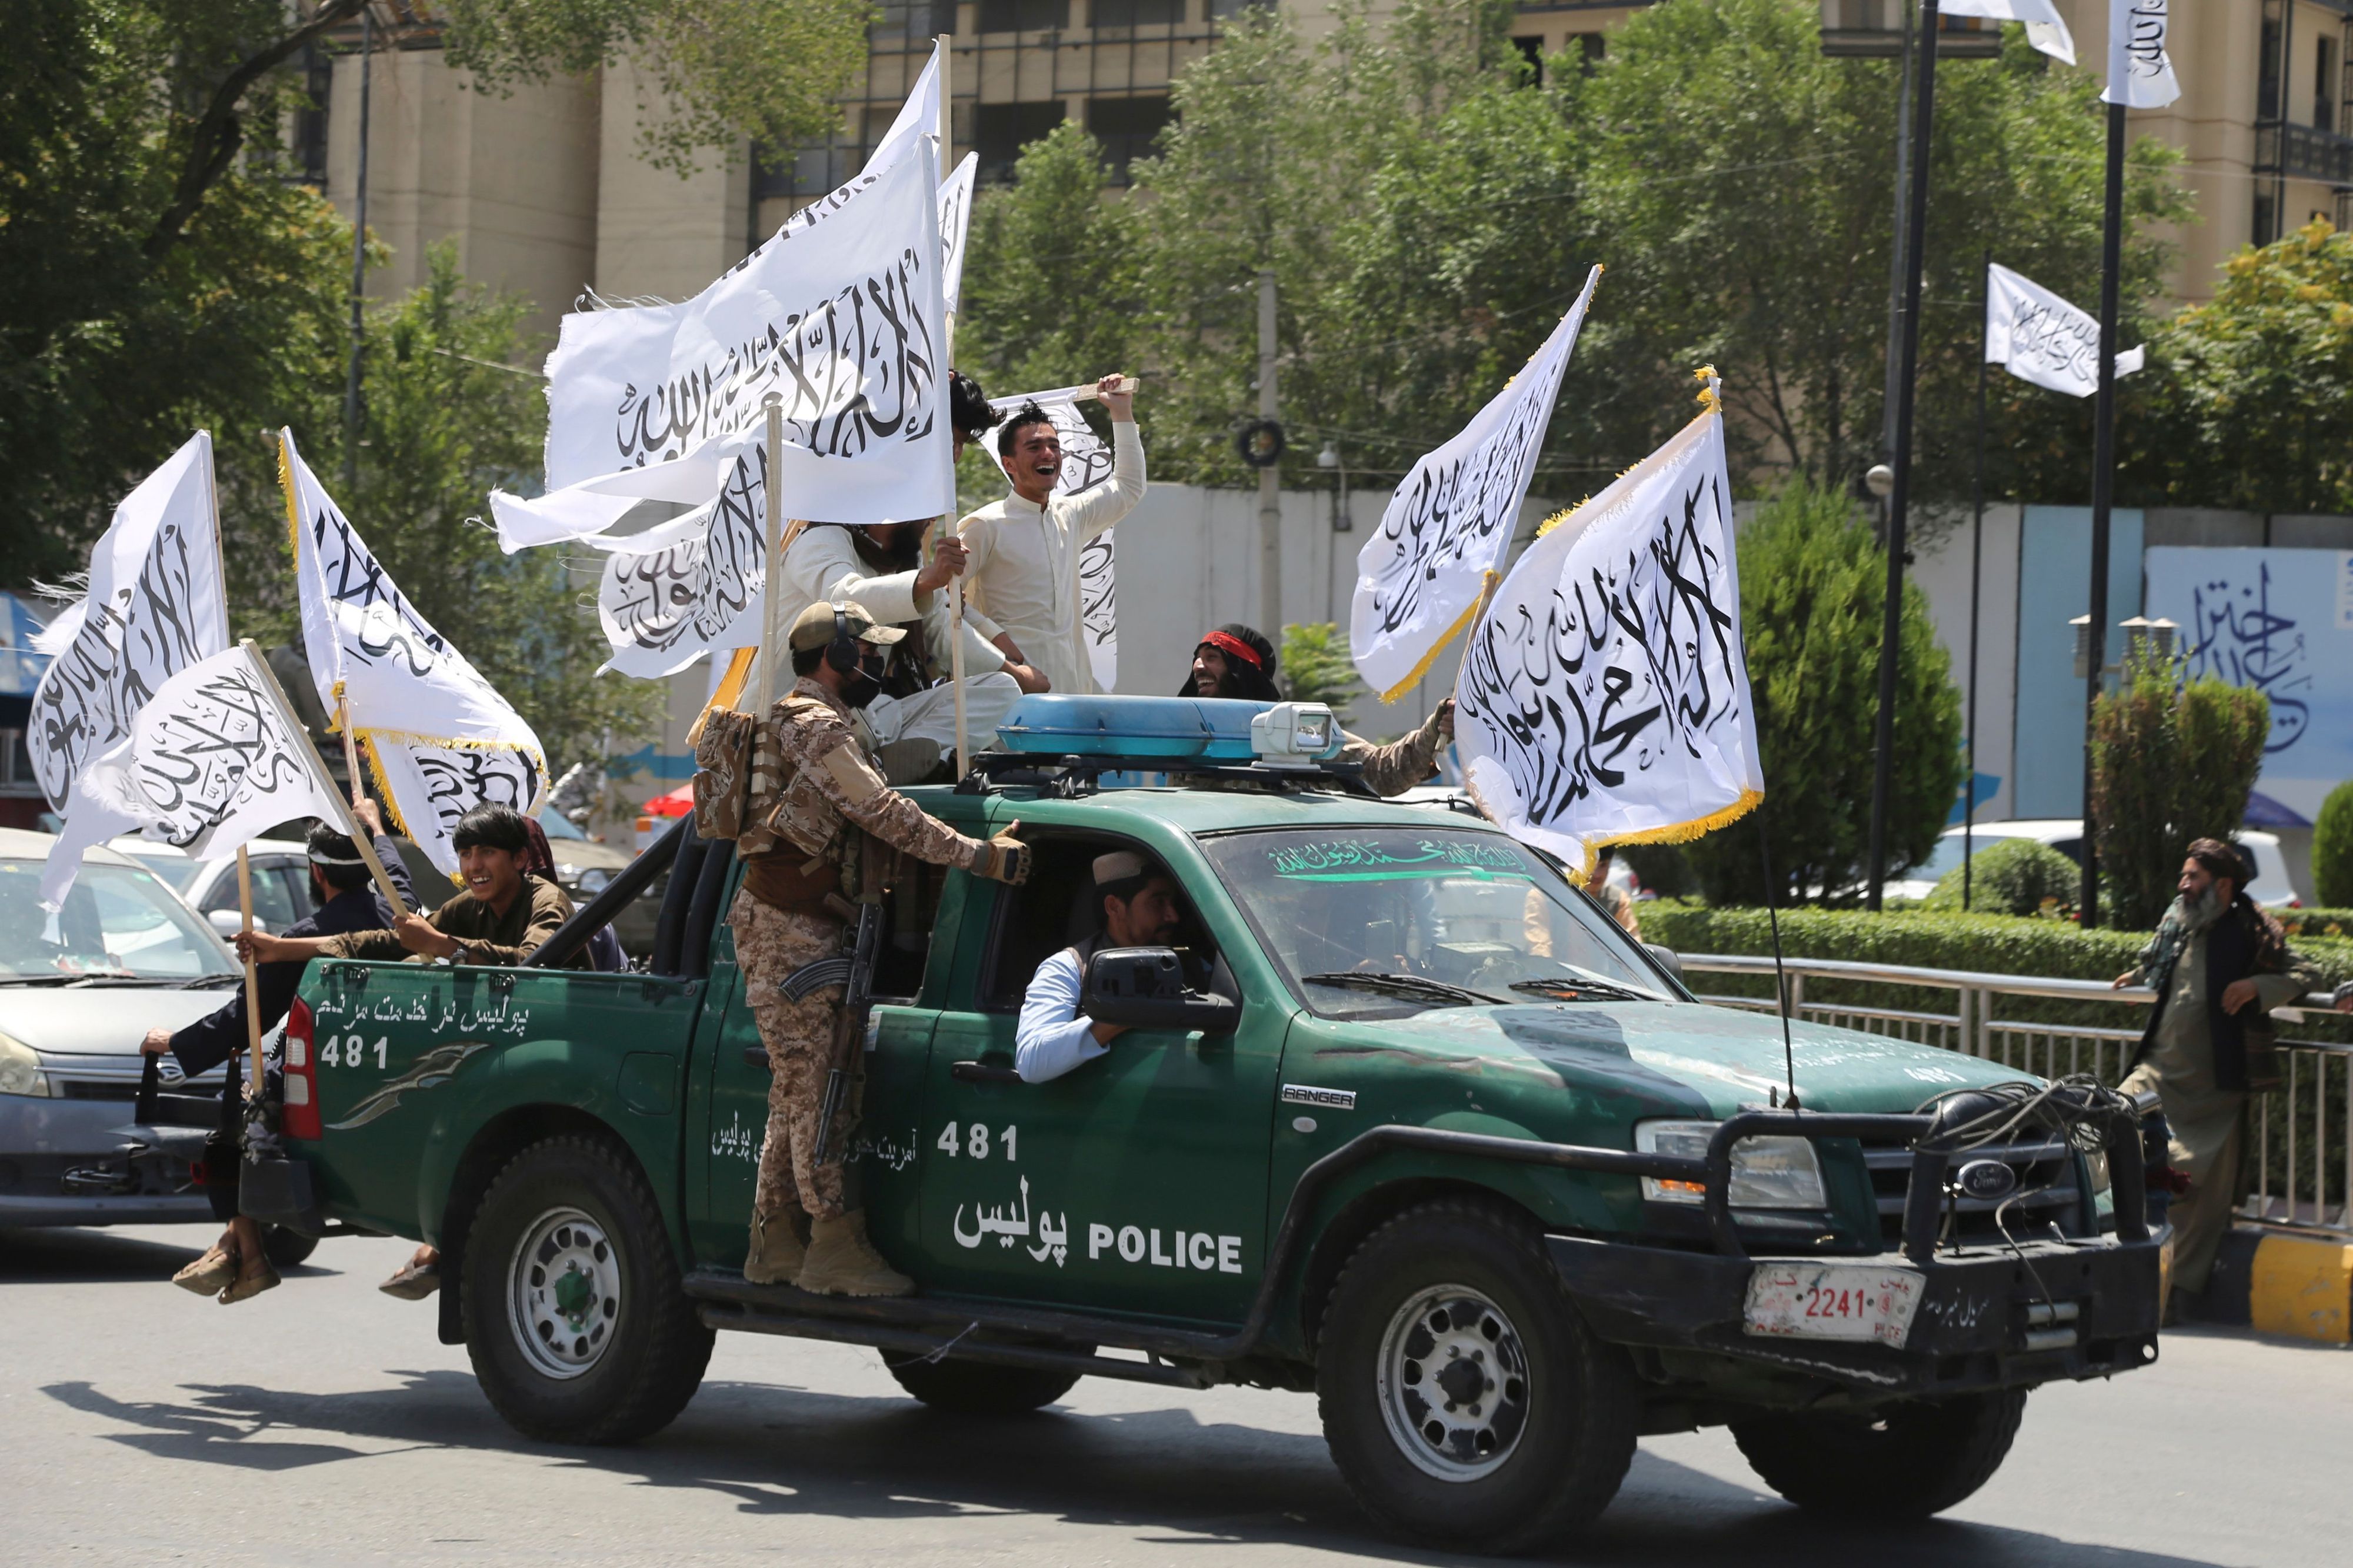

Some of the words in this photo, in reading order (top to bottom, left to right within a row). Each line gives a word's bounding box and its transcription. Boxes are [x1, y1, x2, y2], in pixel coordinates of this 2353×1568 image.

[460, 994, 529, 1037] پولیس
[321, 1035, 388, 1069] 481
[1284, 1088, 1353, 1106] RANGER
[938, 1121, 1018, 1162] 481
[954, 1175, 1068, 1268] پولیس
[1089, 1223, 1242, 1275] POLICE
[1806, 1287, 1864, 1318] 2241
